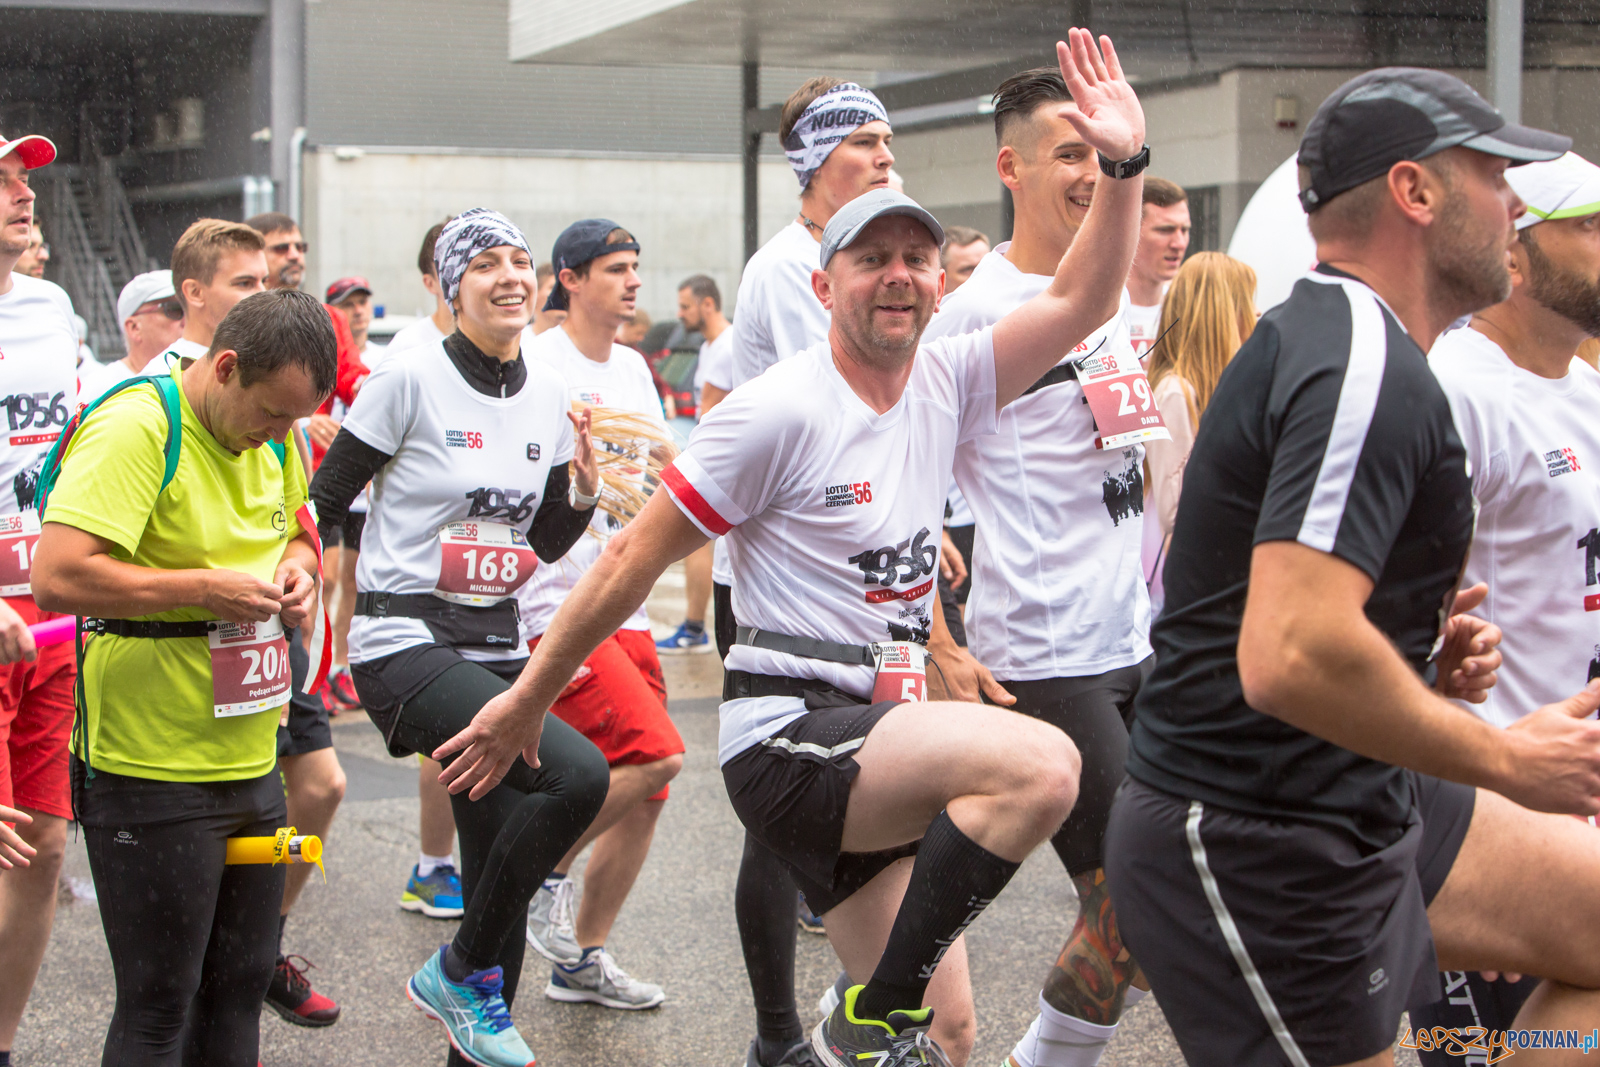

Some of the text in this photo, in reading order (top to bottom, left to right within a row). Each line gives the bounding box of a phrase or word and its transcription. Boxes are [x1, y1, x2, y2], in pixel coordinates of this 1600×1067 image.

[0, 390, 68, 431] 1956
[446, 429, 463, 438] LOTTO
[463, 430, 483, 450] '56
[825, 484, 849, 495] LOTTO
[849, 481, 872, 505] '56
[465, 486, 537, 524] 1956
[825, 498, 855, 508] CZERWIEC
[462, 548, 519, 583] 168
[848, 526, 937, 587] 1956
[469, 584, 507, 594] MICHALINA
[218, 622, 236, 630] LOTTO
[240, 645, 287, 686] 20/1
